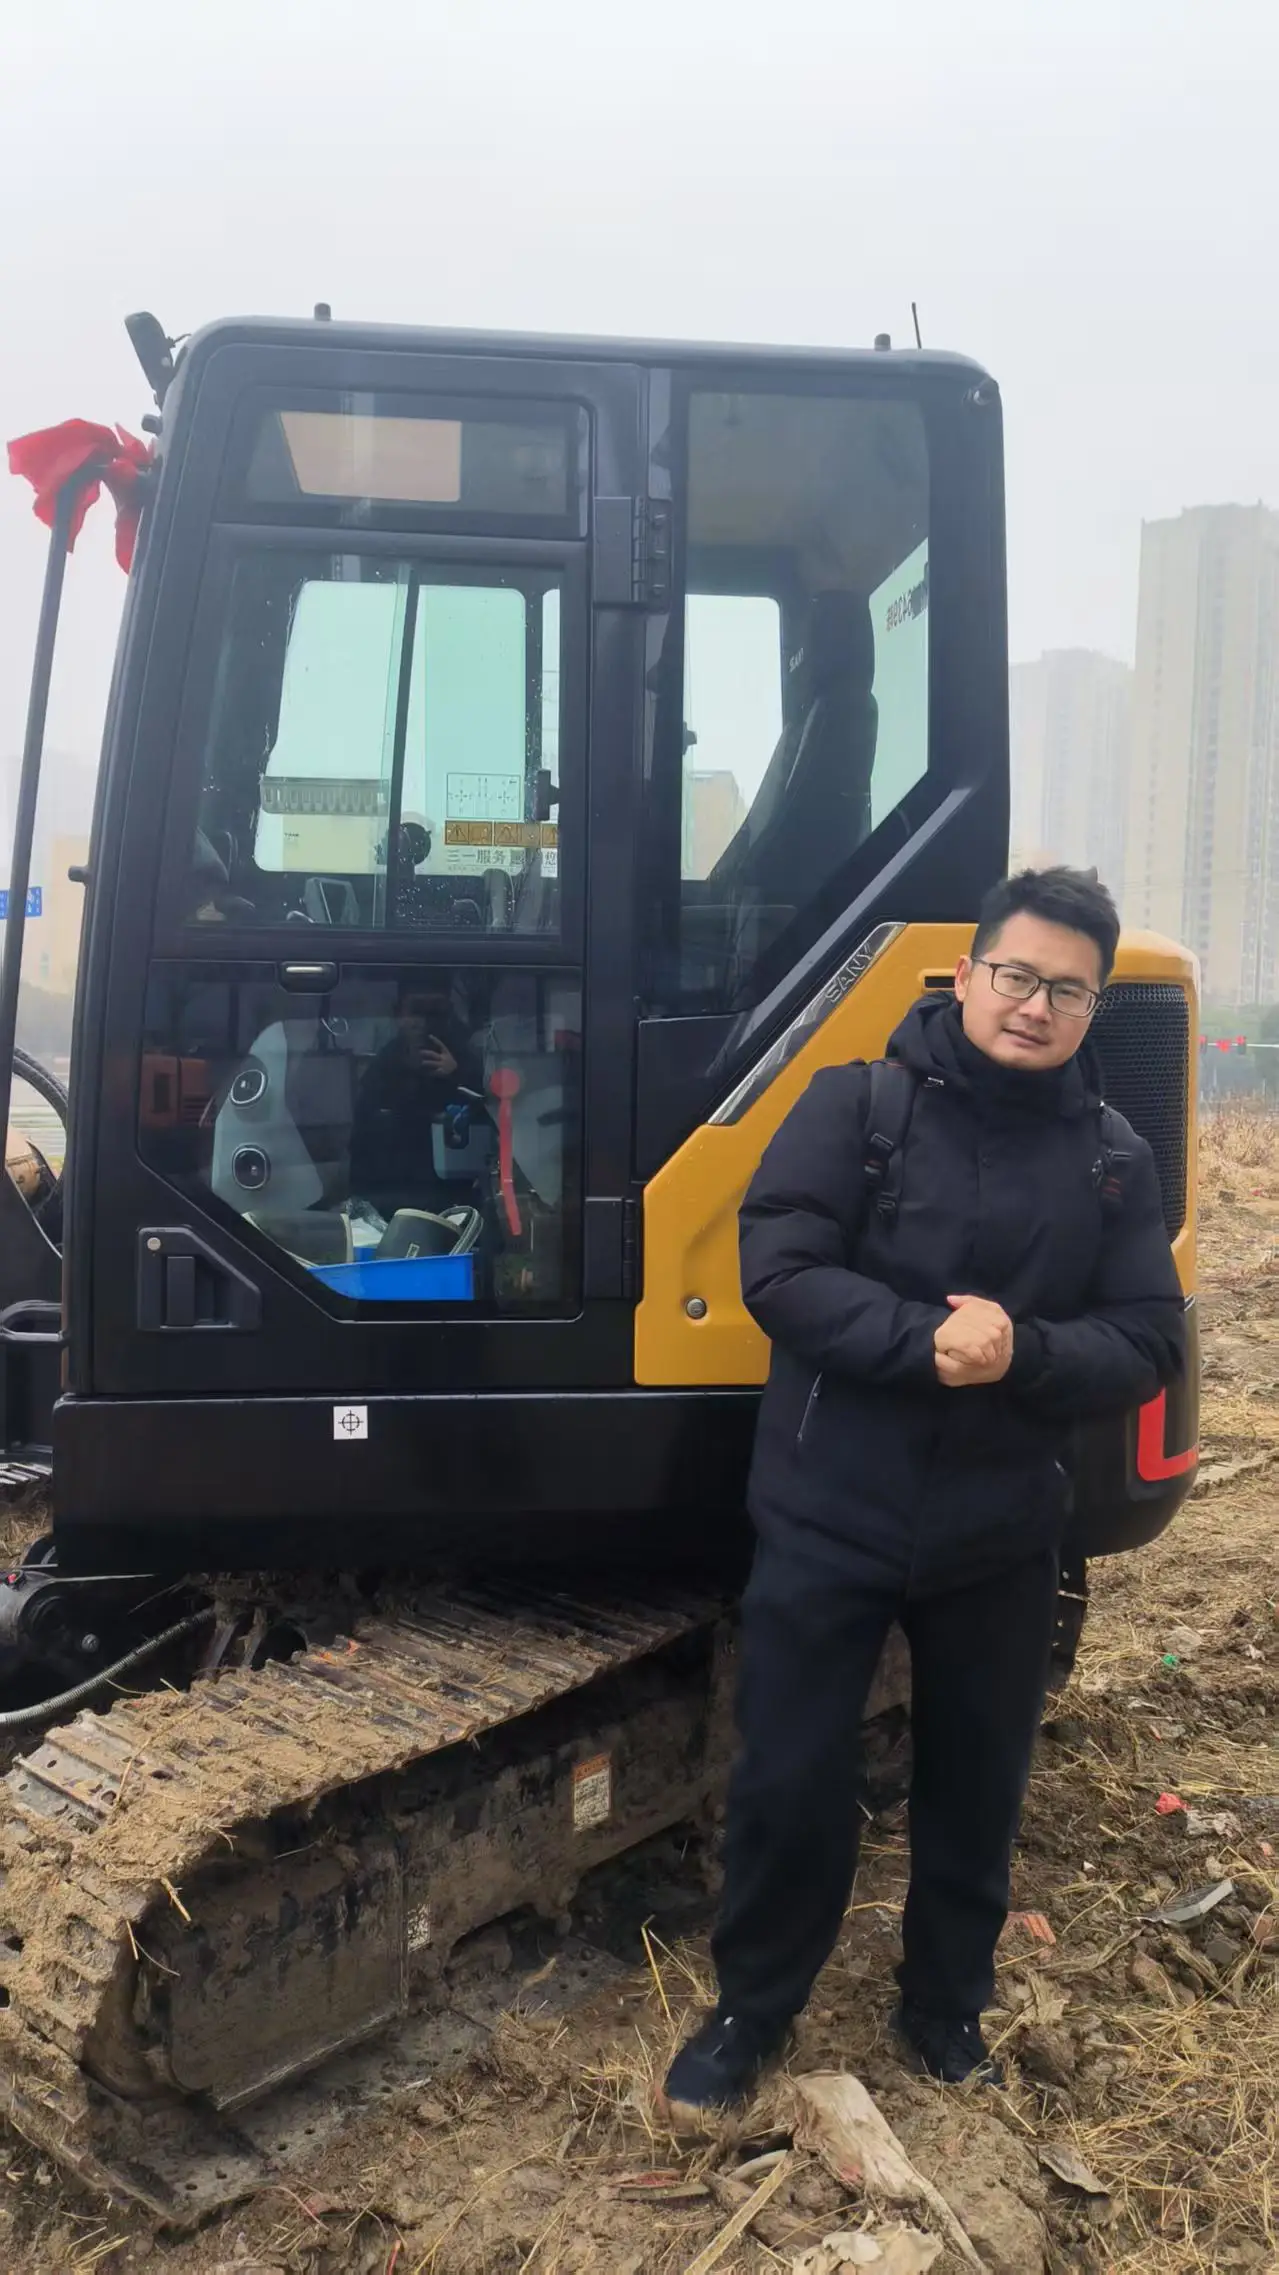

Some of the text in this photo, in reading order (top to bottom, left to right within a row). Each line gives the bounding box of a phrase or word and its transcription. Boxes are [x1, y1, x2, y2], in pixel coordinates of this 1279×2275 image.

[446, 848, 506, 865] 三一服务
[824, 942, 873, 1003] SANY
